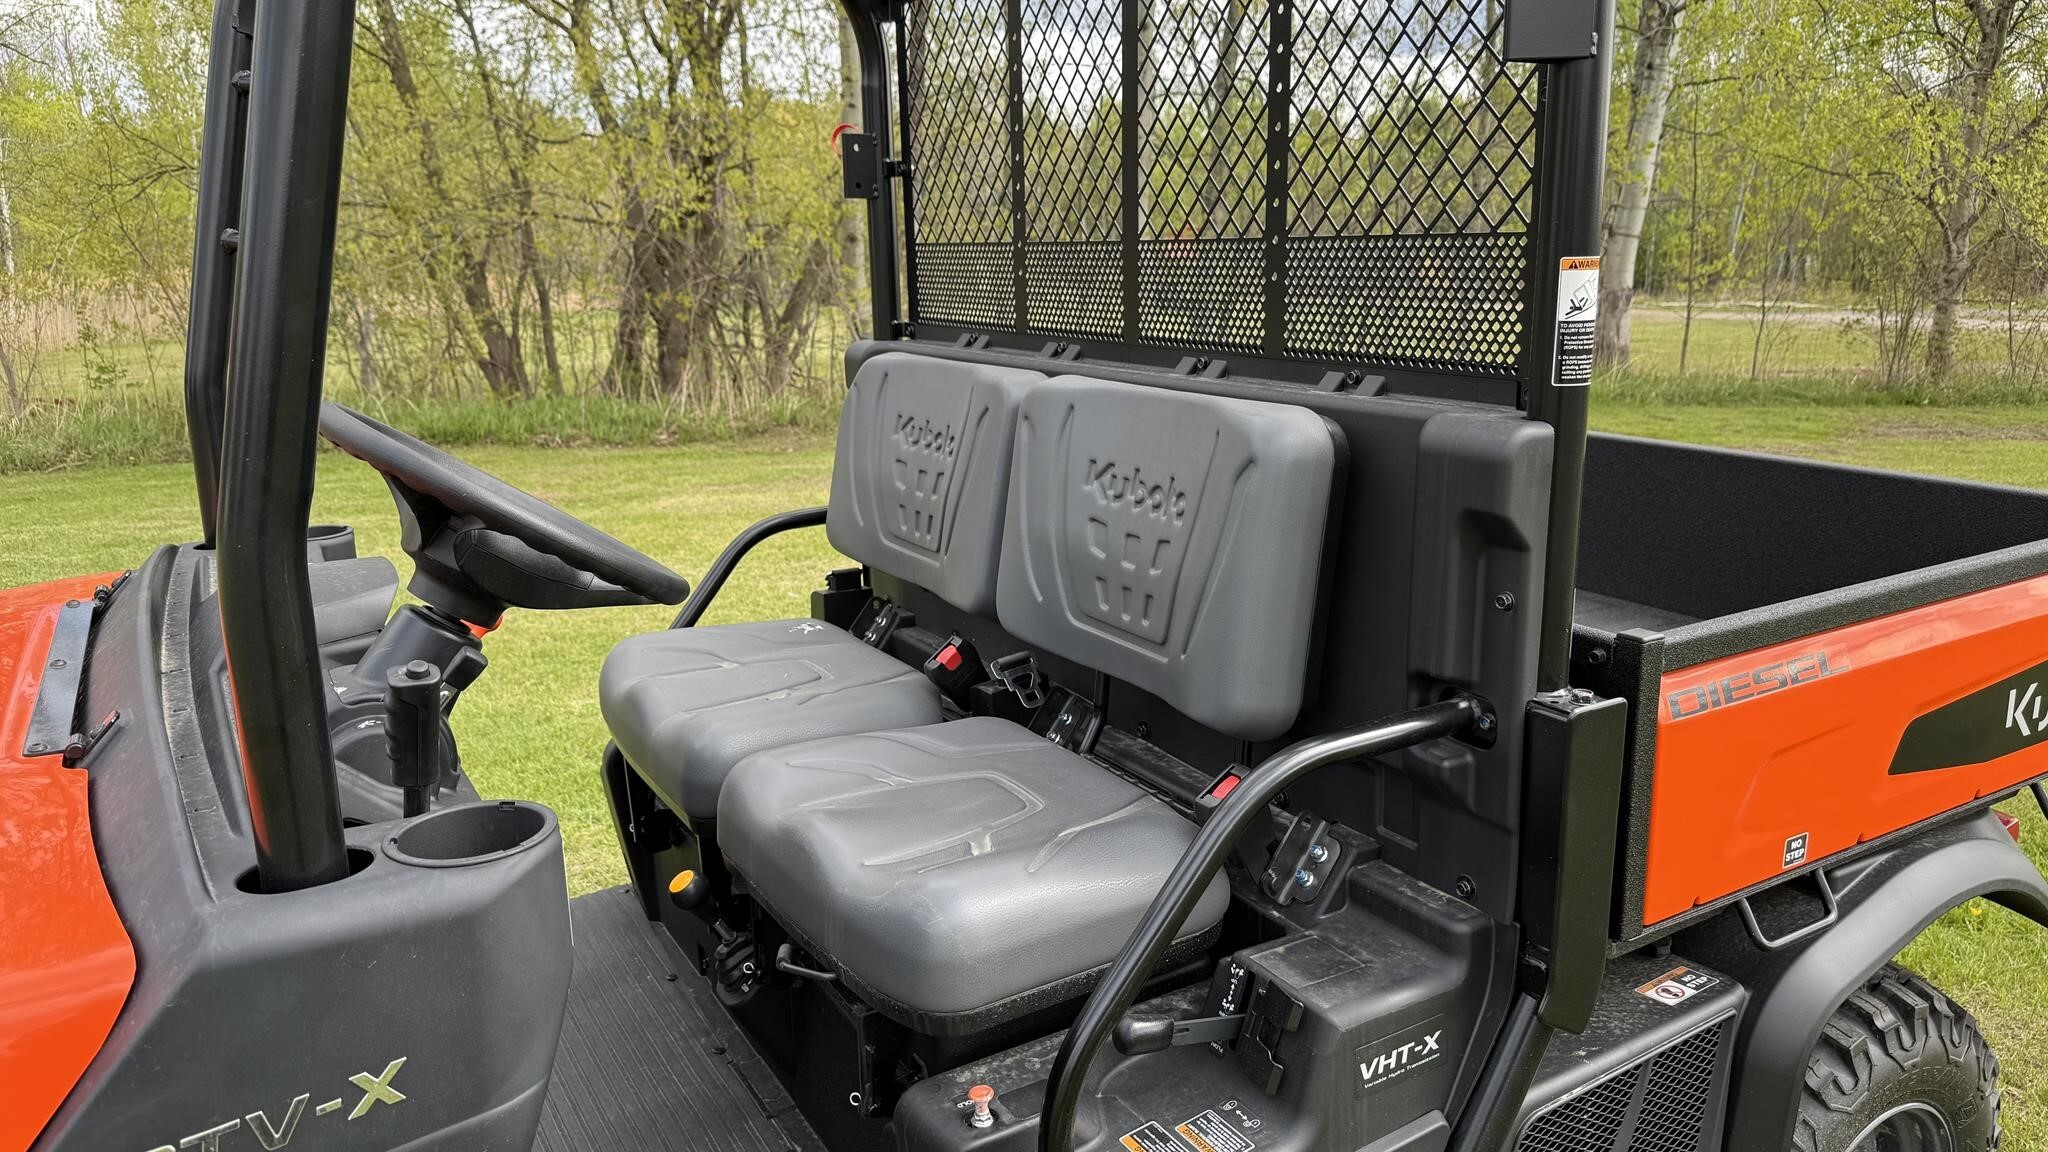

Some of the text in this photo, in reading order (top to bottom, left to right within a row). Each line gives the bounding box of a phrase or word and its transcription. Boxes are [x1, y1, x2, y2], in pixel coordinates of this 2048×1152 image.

[1666, 649, 1850, 722] DIESEL
[1791, 838, 1803, 850] NO
[1786, 848, 1805, 862] STEP
[1680, 973, 1697, 983] NO
[1686, 976, 1708, 988] STEP
[1359, 1029, 1442, 1081] VHT-X
